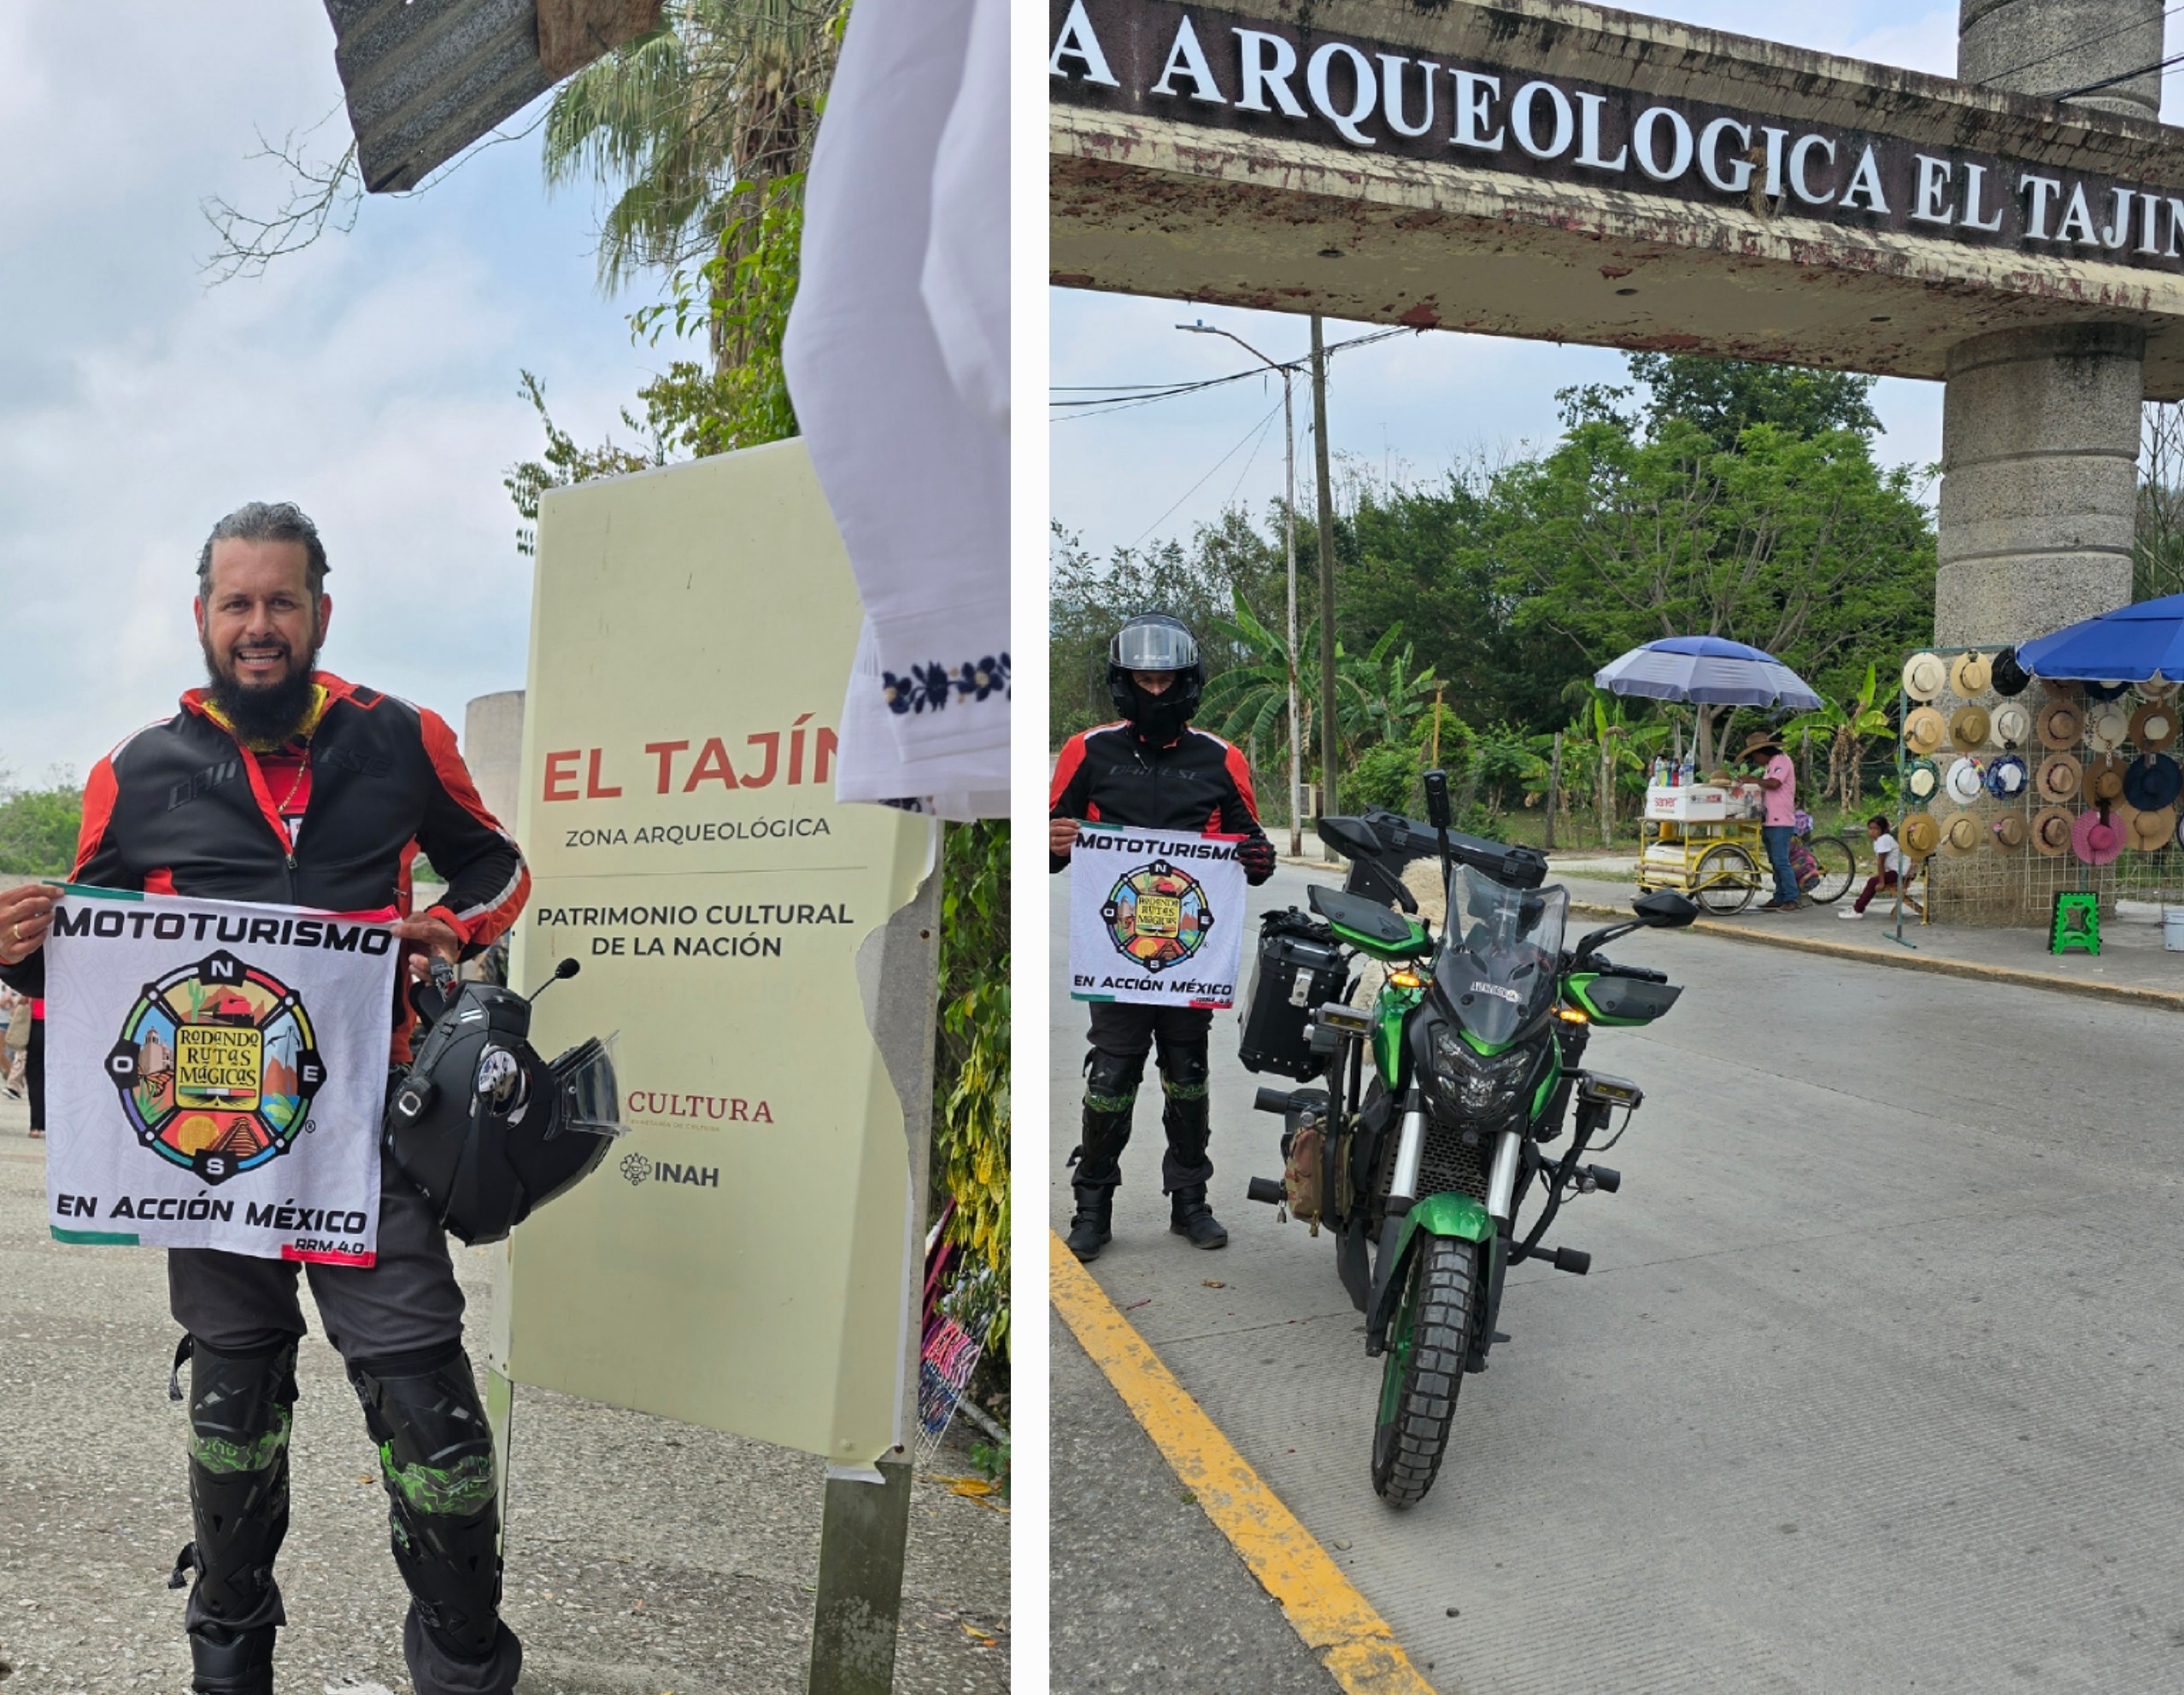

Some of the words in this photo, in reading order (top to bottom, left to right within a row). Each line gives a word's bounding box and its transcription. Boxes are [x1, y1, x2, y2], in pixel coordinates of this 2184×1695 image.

[1150, 15, 1891, 214] ARQUEOLOGICA
[1911, 153, 2004, 232] EL
[543, 748, 623, 802] EL
[565, 828, 628, 848] ZONA
[633, 816, 831, 846] ARQUEOLÓGICA
[1154, 864, 1167, 873] N
[537, 906, 697, 926] PATRIMONIO
[706, 903, 854, 925] CULTURAL
[52, 906, 394, 956] MOTOTURISMO
[591, 936, 625, 956] DE
[633, 937, 666, 956] LA
[672, 931, 783, 958] NACIÓN
[210, 959, 234, 978] N
[1073, 974, 1095, 987] EN
[1101, 975, 1164, 991] ACCIÓN
[1170, 978, 1232, 995] MÉXICO
[112, 1055, 134, 1073] O
[302, 1065, 320, 1082] E
[627, 1090, 775, 1124] CULTURA
[206, 1158, 225, 1176] S
[655, 1162, 719, 1188] INAH
[56, 1193, 98, 1218] EN
[109, 1190, 235, 1223] ACCIÓN
[244, 1198, 367, 1235] MÉXICO
[294, 1238, 334, 1252] RRM
[338, 1240, 365, 1255] 4.0
